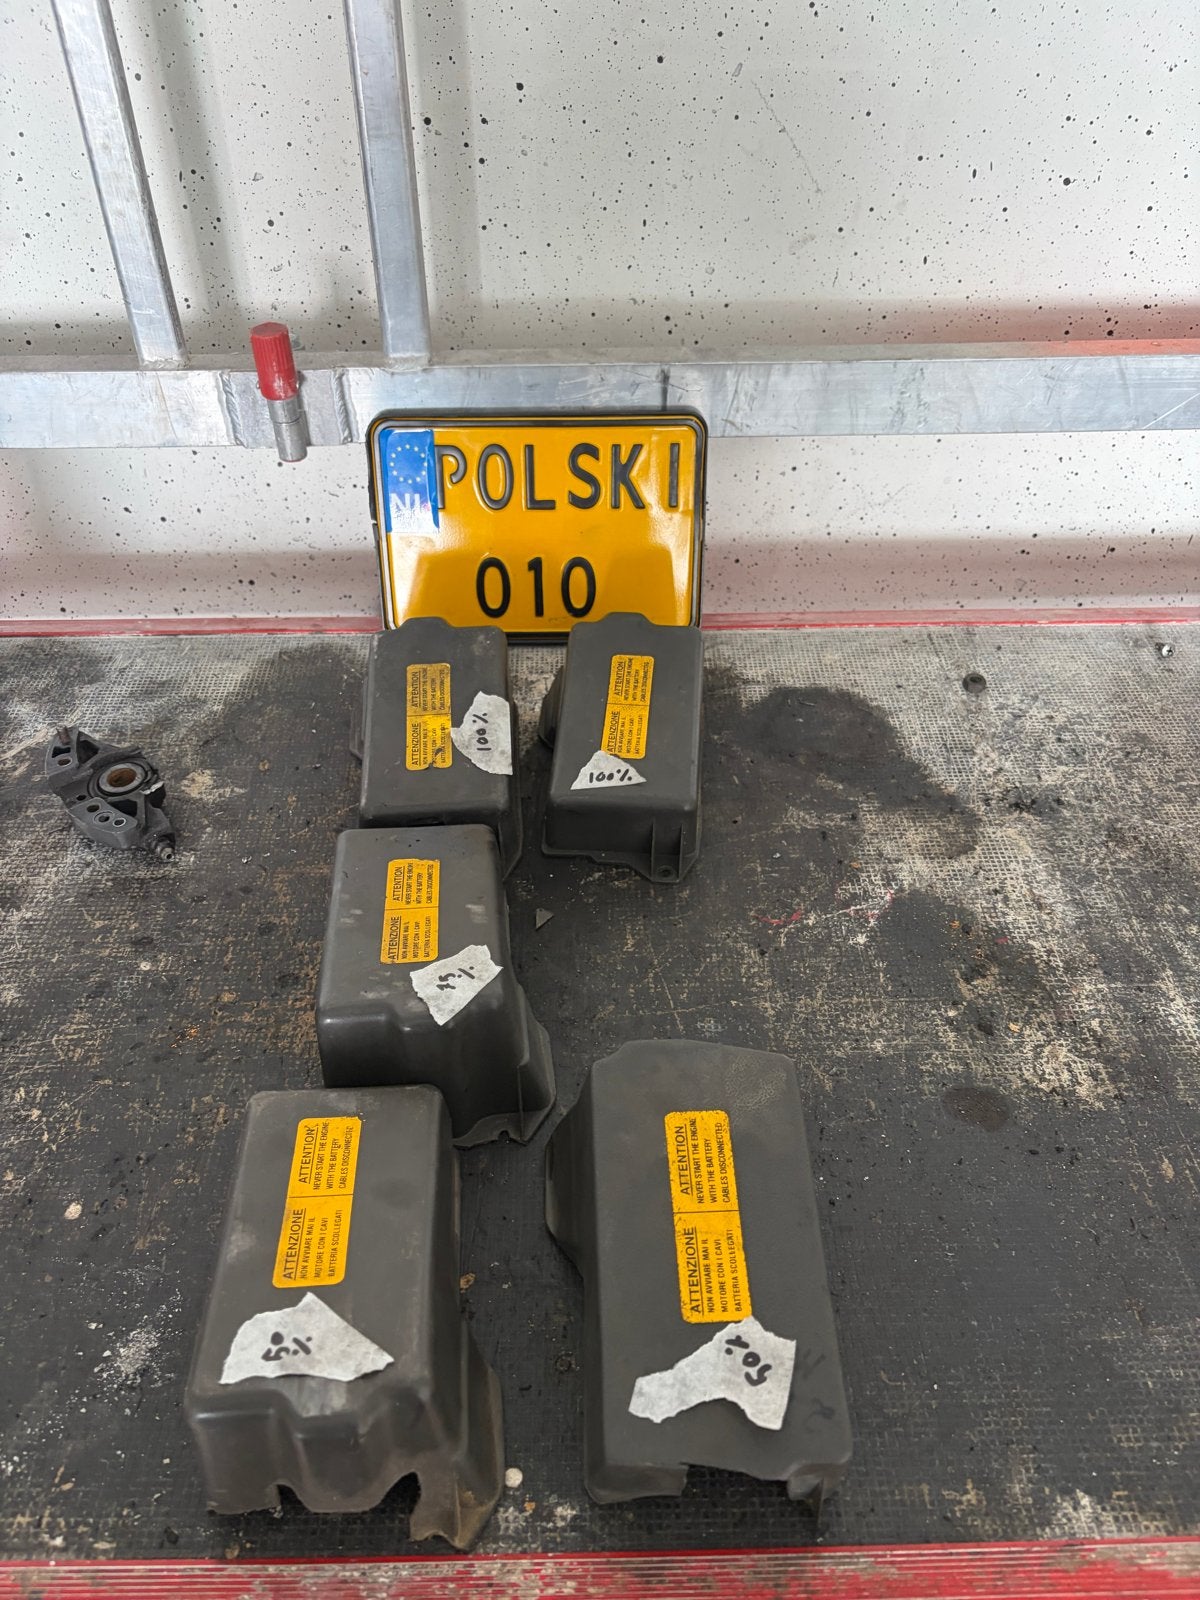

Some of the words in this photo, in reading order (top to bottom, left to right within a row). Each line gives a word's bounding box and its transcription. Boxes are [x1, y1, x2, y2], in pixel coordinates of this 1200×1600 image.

[436, 443, 680, 510] POLSKI
[476, 556, 597, 618] 010
[411, 671, 419, 708] ATTENTION
[614, 661, 624, 696] ATTENTION
[607, 711, 619, 753] ATTENZIONE
[589, 768, 632, 784] 100%
[393, 867, 403, 902] ATTENTION
[388, 916, 399, 960] ATTENZIONE
[320, 1121, 329, 1141] ENGINE
[689, 1117, 699, 1141] ENGINE
[298, 1127, 315, 1184] ATTENTION
[319, 1142, 327, 1152] THE
[330, 1138, 339, 1162] BATTERY
[691, 1143, 700, 1155] THE
[704, 1139, 714, 1169] BATTERY
[715, 1123, 728, 1175] DISCONNECTED
[316, 1153, 325, 1171] START
[328, 1163, 336, 1173] THE
[674, 1126, 691, 1195] ATTENTION
[693, 1158, 703, 1179] START
[313, 1171, 322, 1190] NEVER
[326, 1174, 334, 1190] WITH
[339, 1167, 348, 1189] CABLES
[707, 1170, 716, 1183] THE
[695, 1181, 705, 1204] NEVER
[709, 1184, 718, 1204] WITH
[720, 1176, 730, 1203] CABLES
[306, 1224, 315, 1236] MAI
[320, 1218, 328, 1232] CAVI
[331, 1210, 343, 1246] SCOLLEGATI
[283, 1209, 303, 1279] ATTENZIONE
[302, 1238, 313, 1264] AVVIARE
[318, 1237, 326, 1250] CON
[702, 1247, 710, 1261] MAI
[714, 1240, 723, 1256] CAVI
[726, 1229, 738, 1274] SCOLLEGATI
[300, 1265, 308, 1279] NON
[314, 1252, 325, 1278] MOTORE
[328, 1248, 338, 1277] BATTERIA
[683, 1228, 702, 1314] ATTENZIONE
[717, 1262, 725, 1278] CON
[703, 1264, 713, 1295] AVVIARE
[707, 1298, 715, 1313] NON
[719, 1281, 728, 1313] MOTORE
[732, 1276, 742, 1312] BATTERIA
[724, 1335, 773, 1387] 50%
